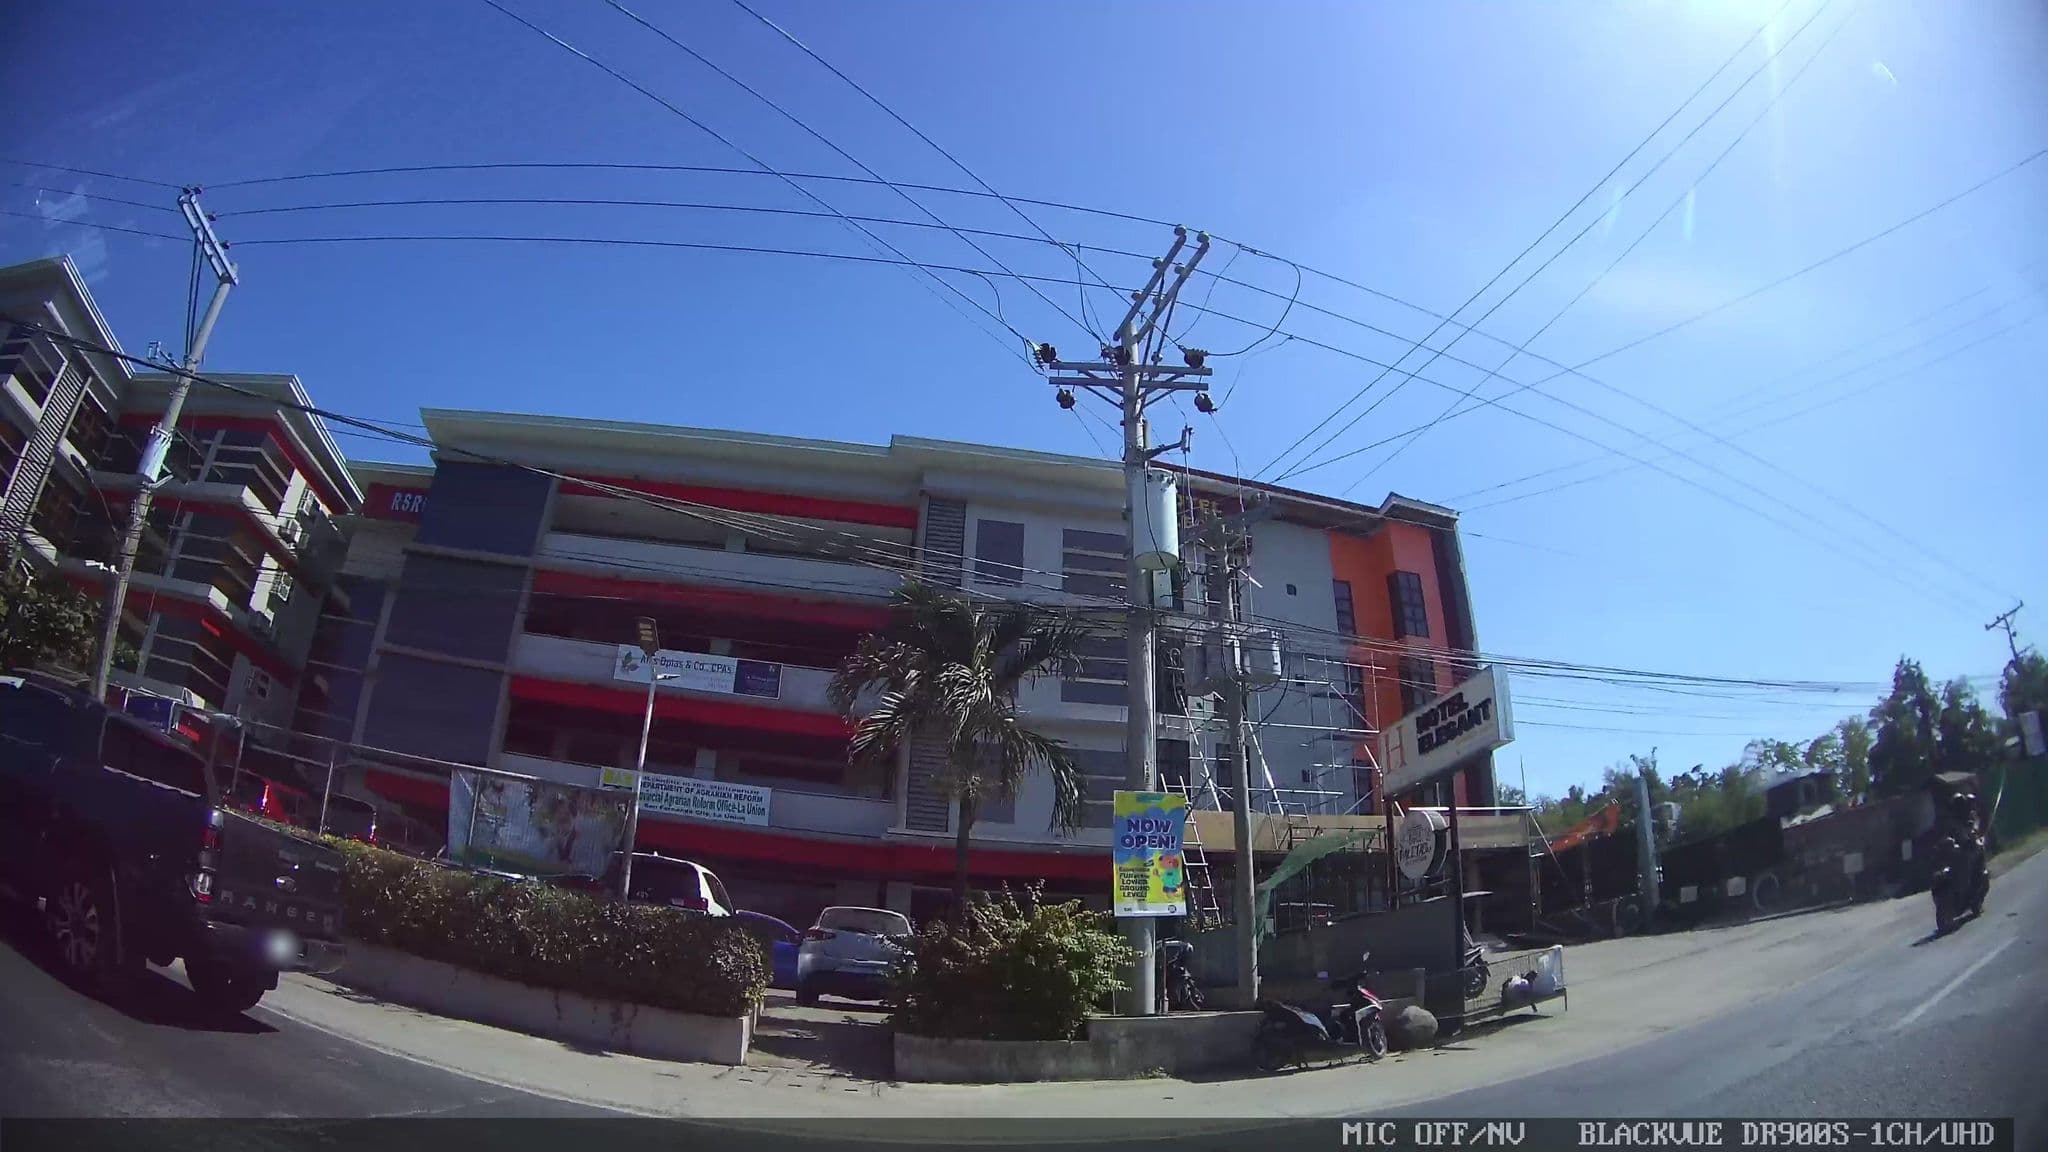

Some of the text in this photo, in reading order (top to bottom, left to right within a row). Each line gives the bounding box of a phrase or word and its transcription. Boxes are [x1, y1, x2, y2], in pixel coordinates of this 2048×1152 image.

[685, 660, 692, 669] &
[711, 662, 732, 674] CPAs
[1416, 692, 1469, 734] HOTEL
[685, 786, 695, 795] OF
[695, 789, 732, 799] AGRARIAN
[733, 792, 763, 803] REFORM
[639, 789, 663, 803] ovincial
[664, 791, 690, 808] Agrarian
[747, 802, 766, 817] Union
[1127, 818, 1173, 834] NOW
[1120, 834, 1177, 850] OPEN!
